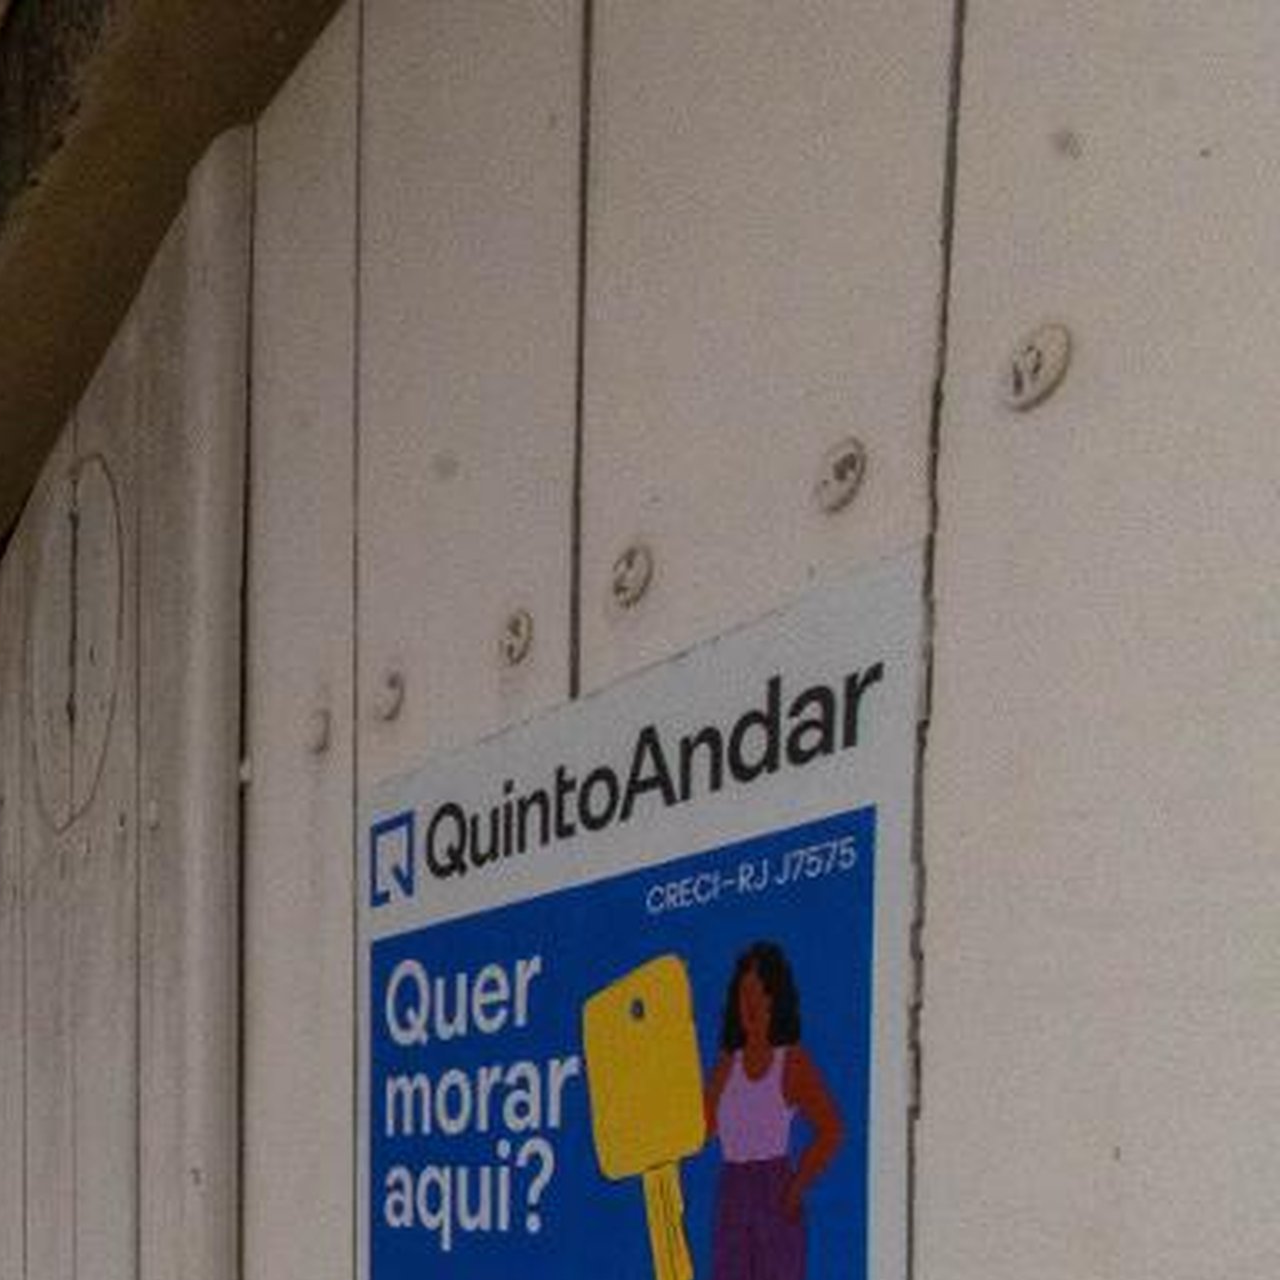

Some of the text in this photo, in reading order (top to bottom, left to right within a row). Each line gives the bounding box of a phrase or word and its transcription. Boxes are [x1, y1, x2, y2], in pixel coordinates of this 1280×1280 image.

[424, 660, 884, 879] QuintoAndar
[775, 835, 857, 883] J7575
[385, 954, 543, 1046] Quer
[385, 1053, 580, 1137] morar
[384, 1139, 556, 1251] aqui?
